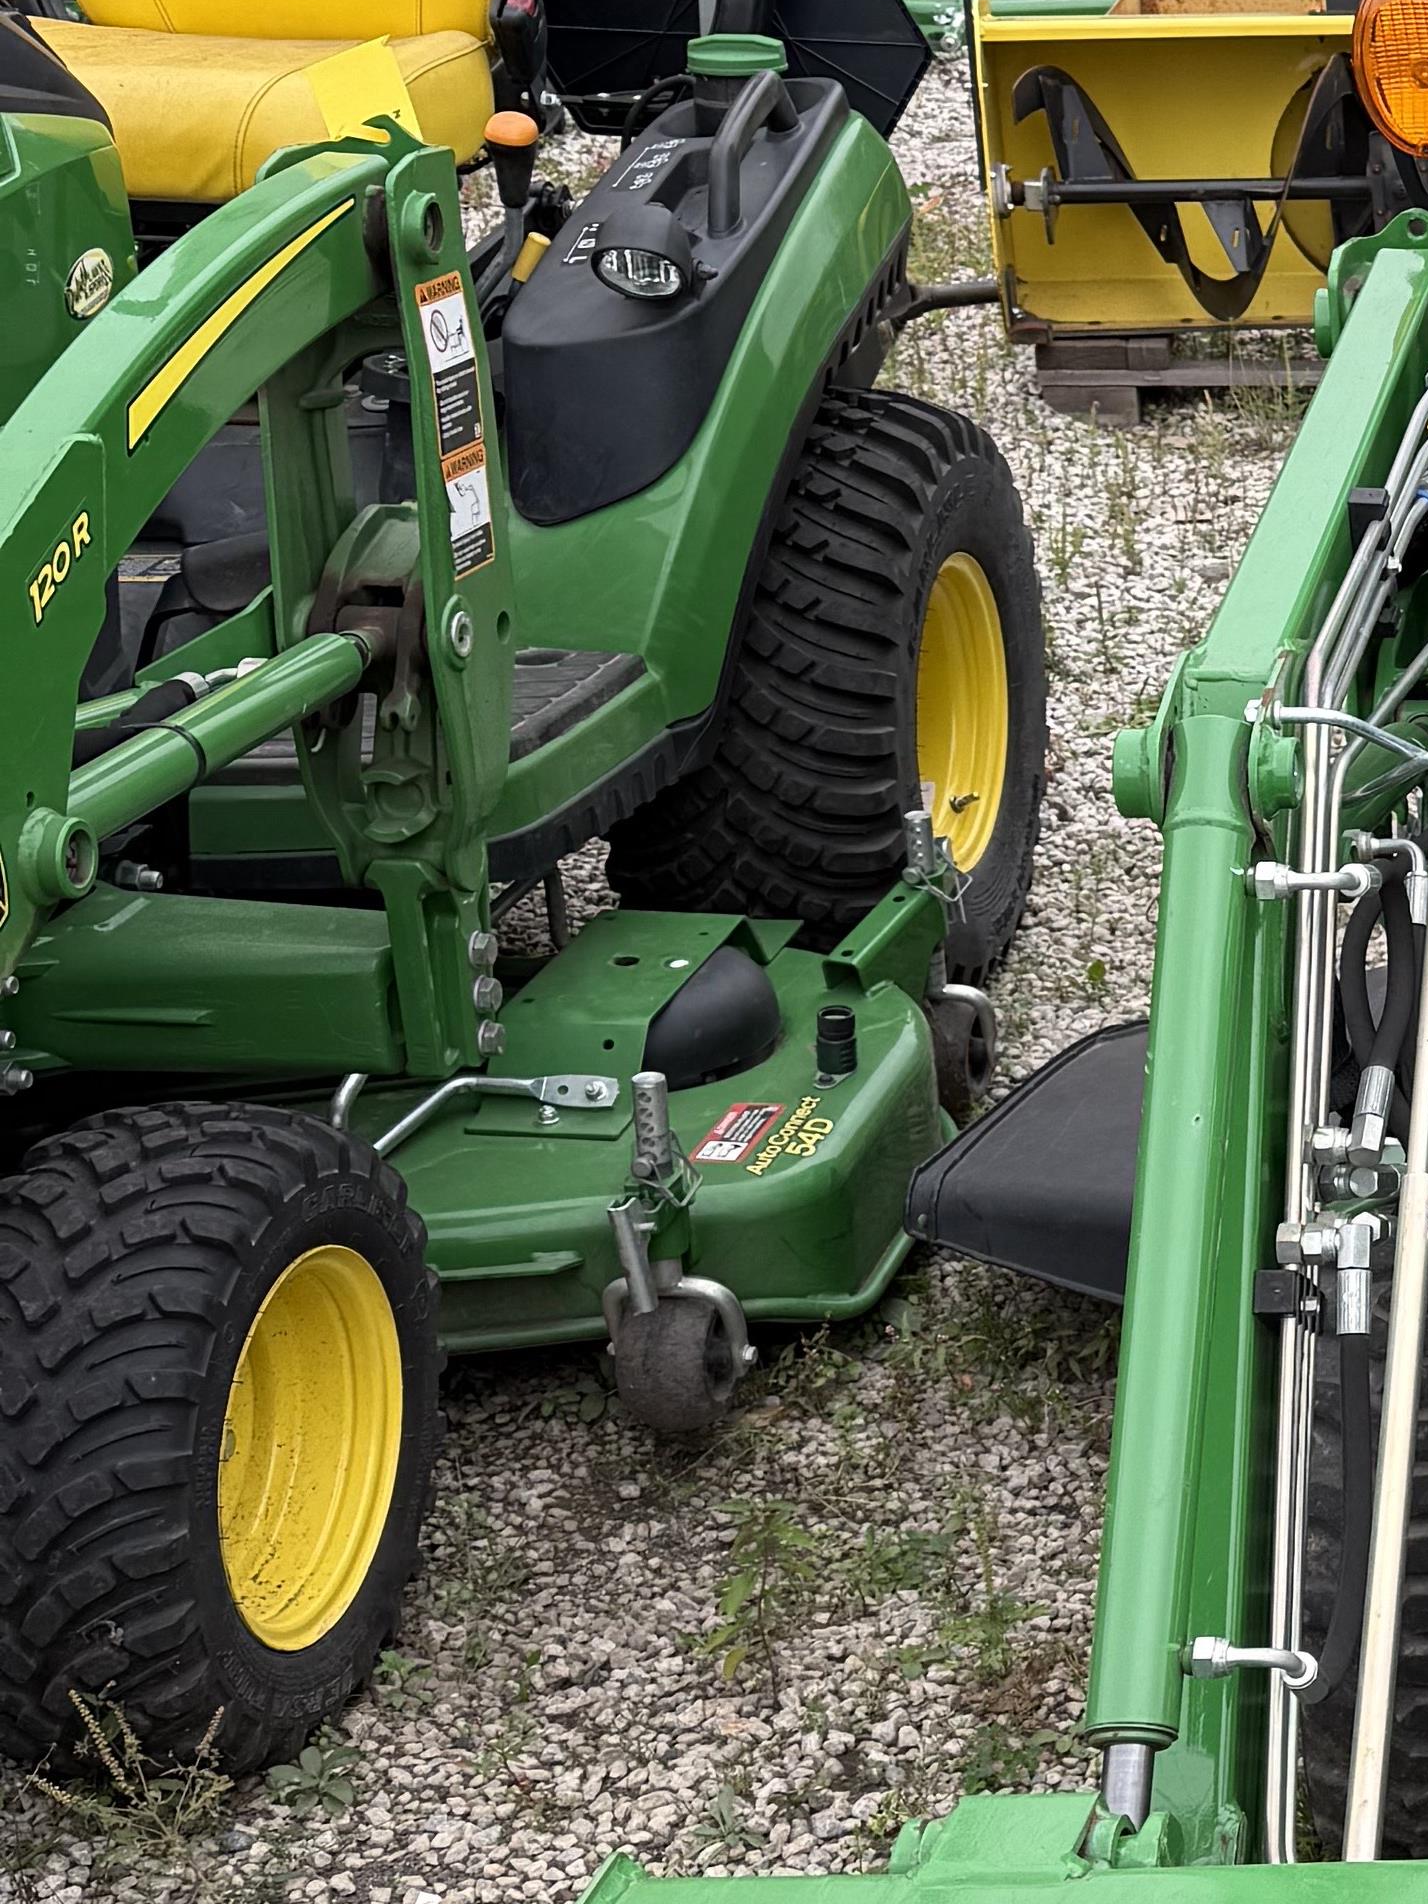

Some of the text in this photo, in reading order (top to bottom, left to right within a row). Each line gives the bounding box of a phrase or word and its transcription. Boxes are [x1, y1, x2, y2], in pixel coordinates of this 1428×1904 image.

[425, 275, 461, 298] WARNING
[450, 448, 485, 476] WARNING
[745, 1095, 821, 1176] AutoConnect
[784, 1117, 835, 1157] 54D
